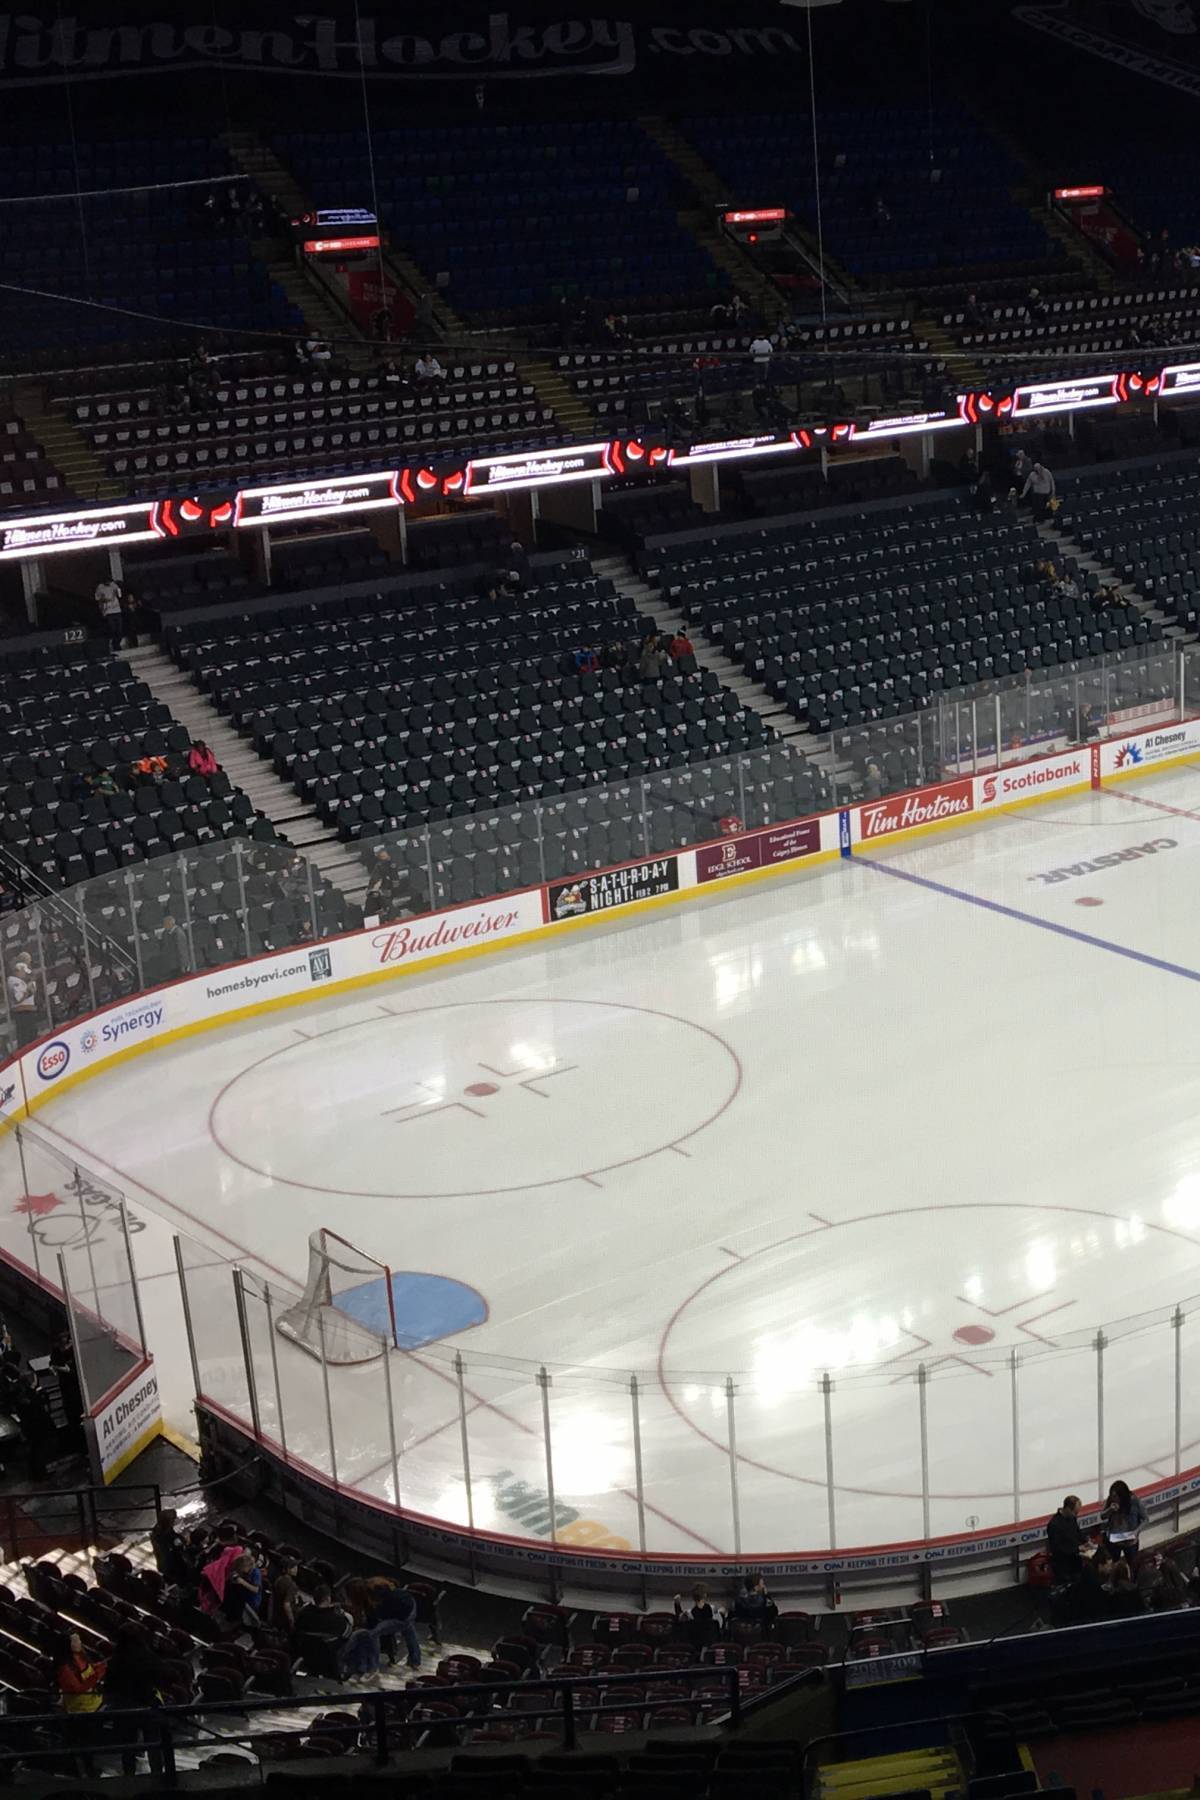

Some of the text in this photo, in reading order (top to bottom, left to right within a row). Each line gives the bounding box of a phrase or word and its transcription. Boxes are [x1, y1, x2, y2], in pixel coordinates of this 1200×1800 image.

[0, 11, 801, 75] itmenHockey.com
[65, 629, 83, 641] 122
[1154, 730, 1186, 747] Chesney
[1003, 761, 1081, 793] Scotiabank
[864, 806, 897, 836] Tim
[901, 794, 969, 827] Hortons
[707, 856, 752, 874] EDGE SCHOOL
[591, 885, 634, 910] NIGHT!
[372, 910, 519, 963] Budweiser
[207, 963, 307, 999] homesbyavi.com
[102, 1007, 163, 1042] Synergy
[42, 1051, 65, 1072] Esso
[102, 1415, 114, 1439] A1
[115, 1376, 158, 1425] Chesney
